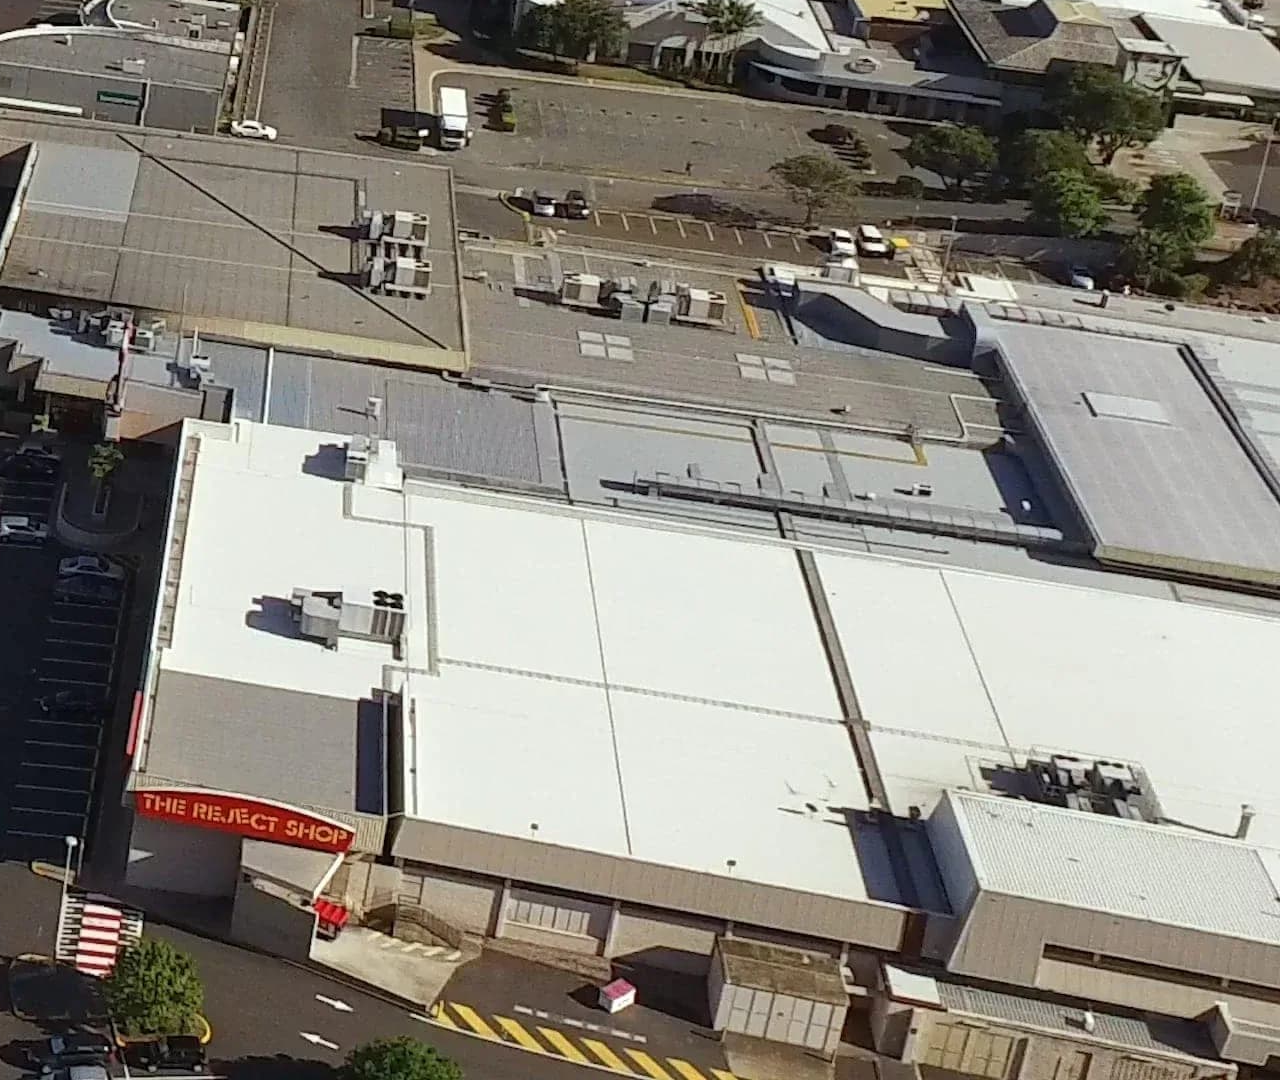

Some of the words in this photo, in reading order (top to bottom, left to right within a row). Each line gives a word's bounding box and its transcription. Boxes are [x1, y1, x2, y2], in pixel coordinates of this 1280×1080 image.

[143, 792, 187, 816] THE
[192, 801, 279, 833] REJECT
[284, 820, 348, 845] SHOP
